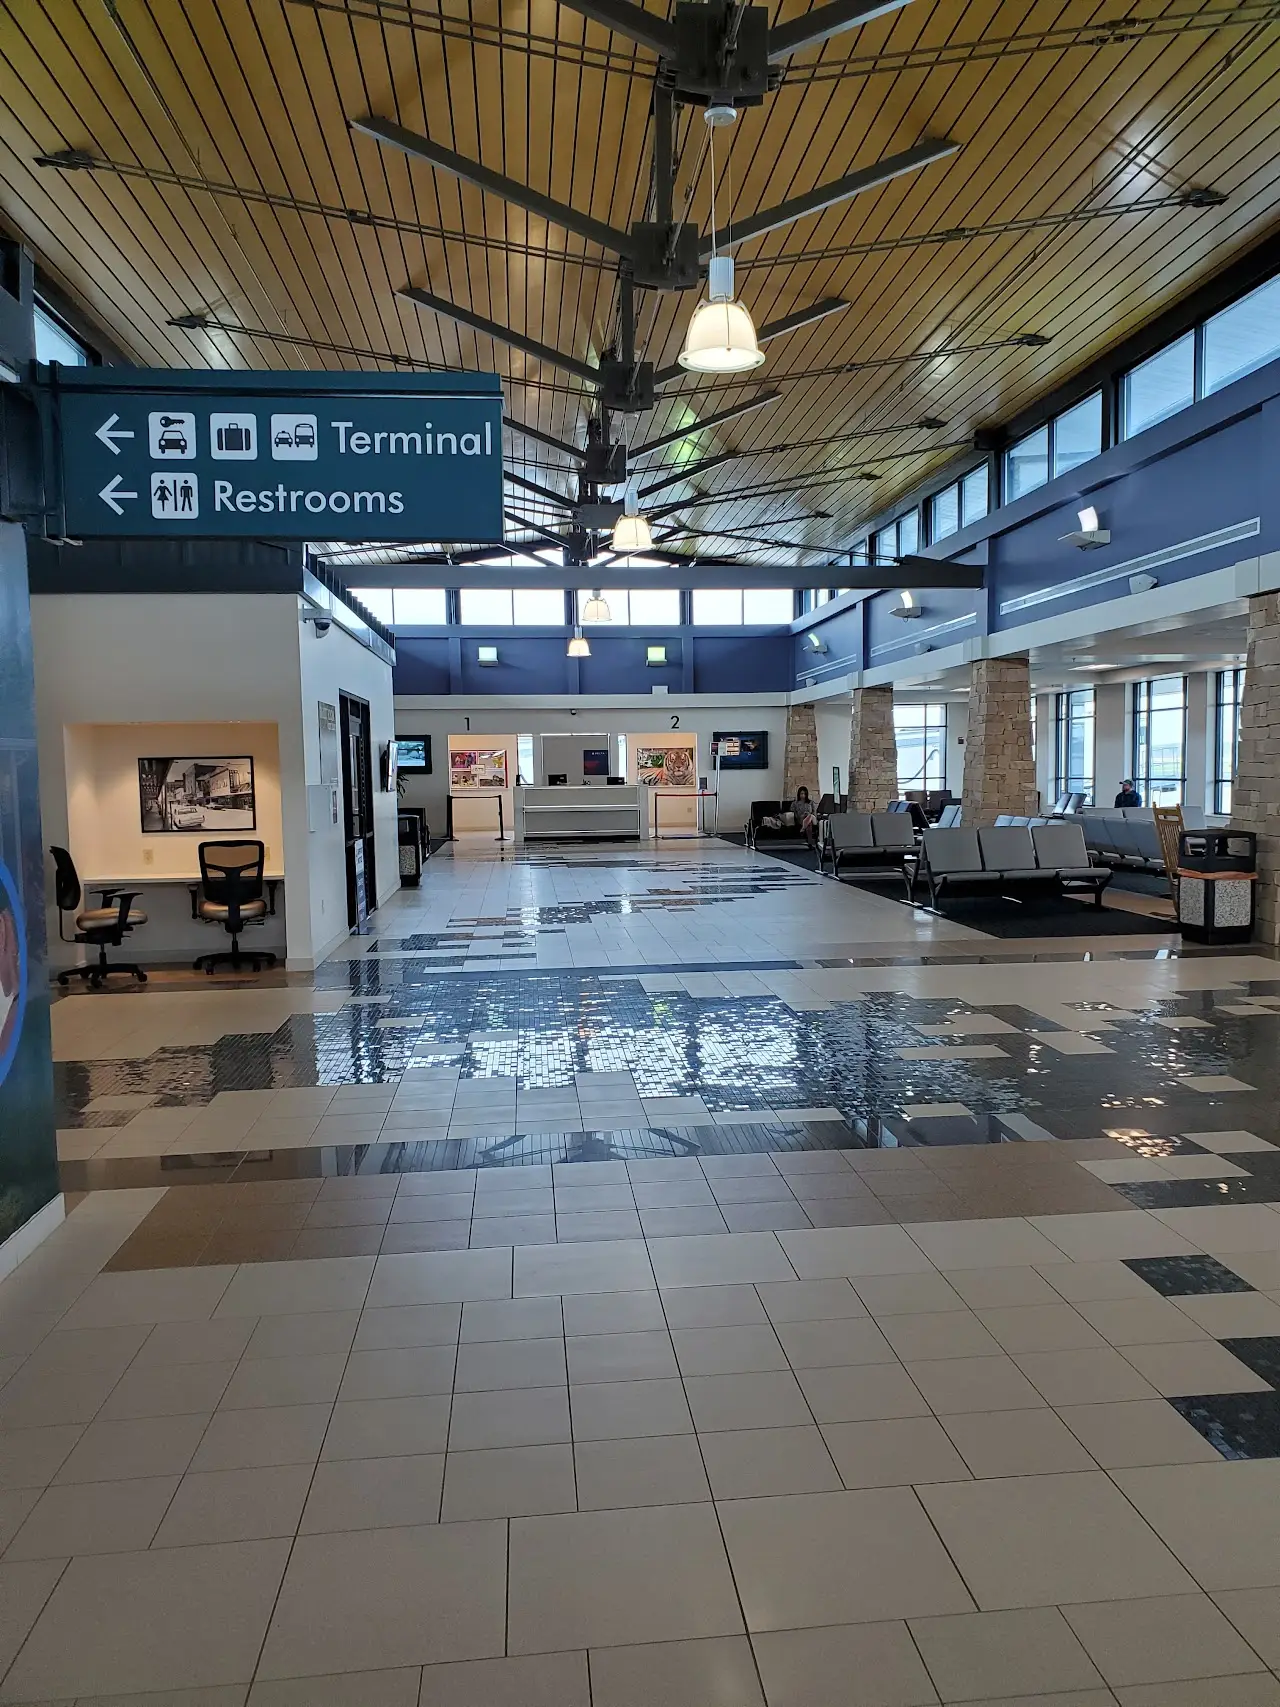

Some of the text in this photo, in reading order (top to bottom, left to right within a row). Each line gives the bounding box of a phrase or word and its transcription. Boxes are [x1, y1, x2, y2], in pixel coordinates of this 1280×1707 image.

[331, 421, 492, 455] Terminal
[214, 480, 405, 514] Restrooms
[464, 717, 471, 731] 1
[671, 716, 680, 729] 2
